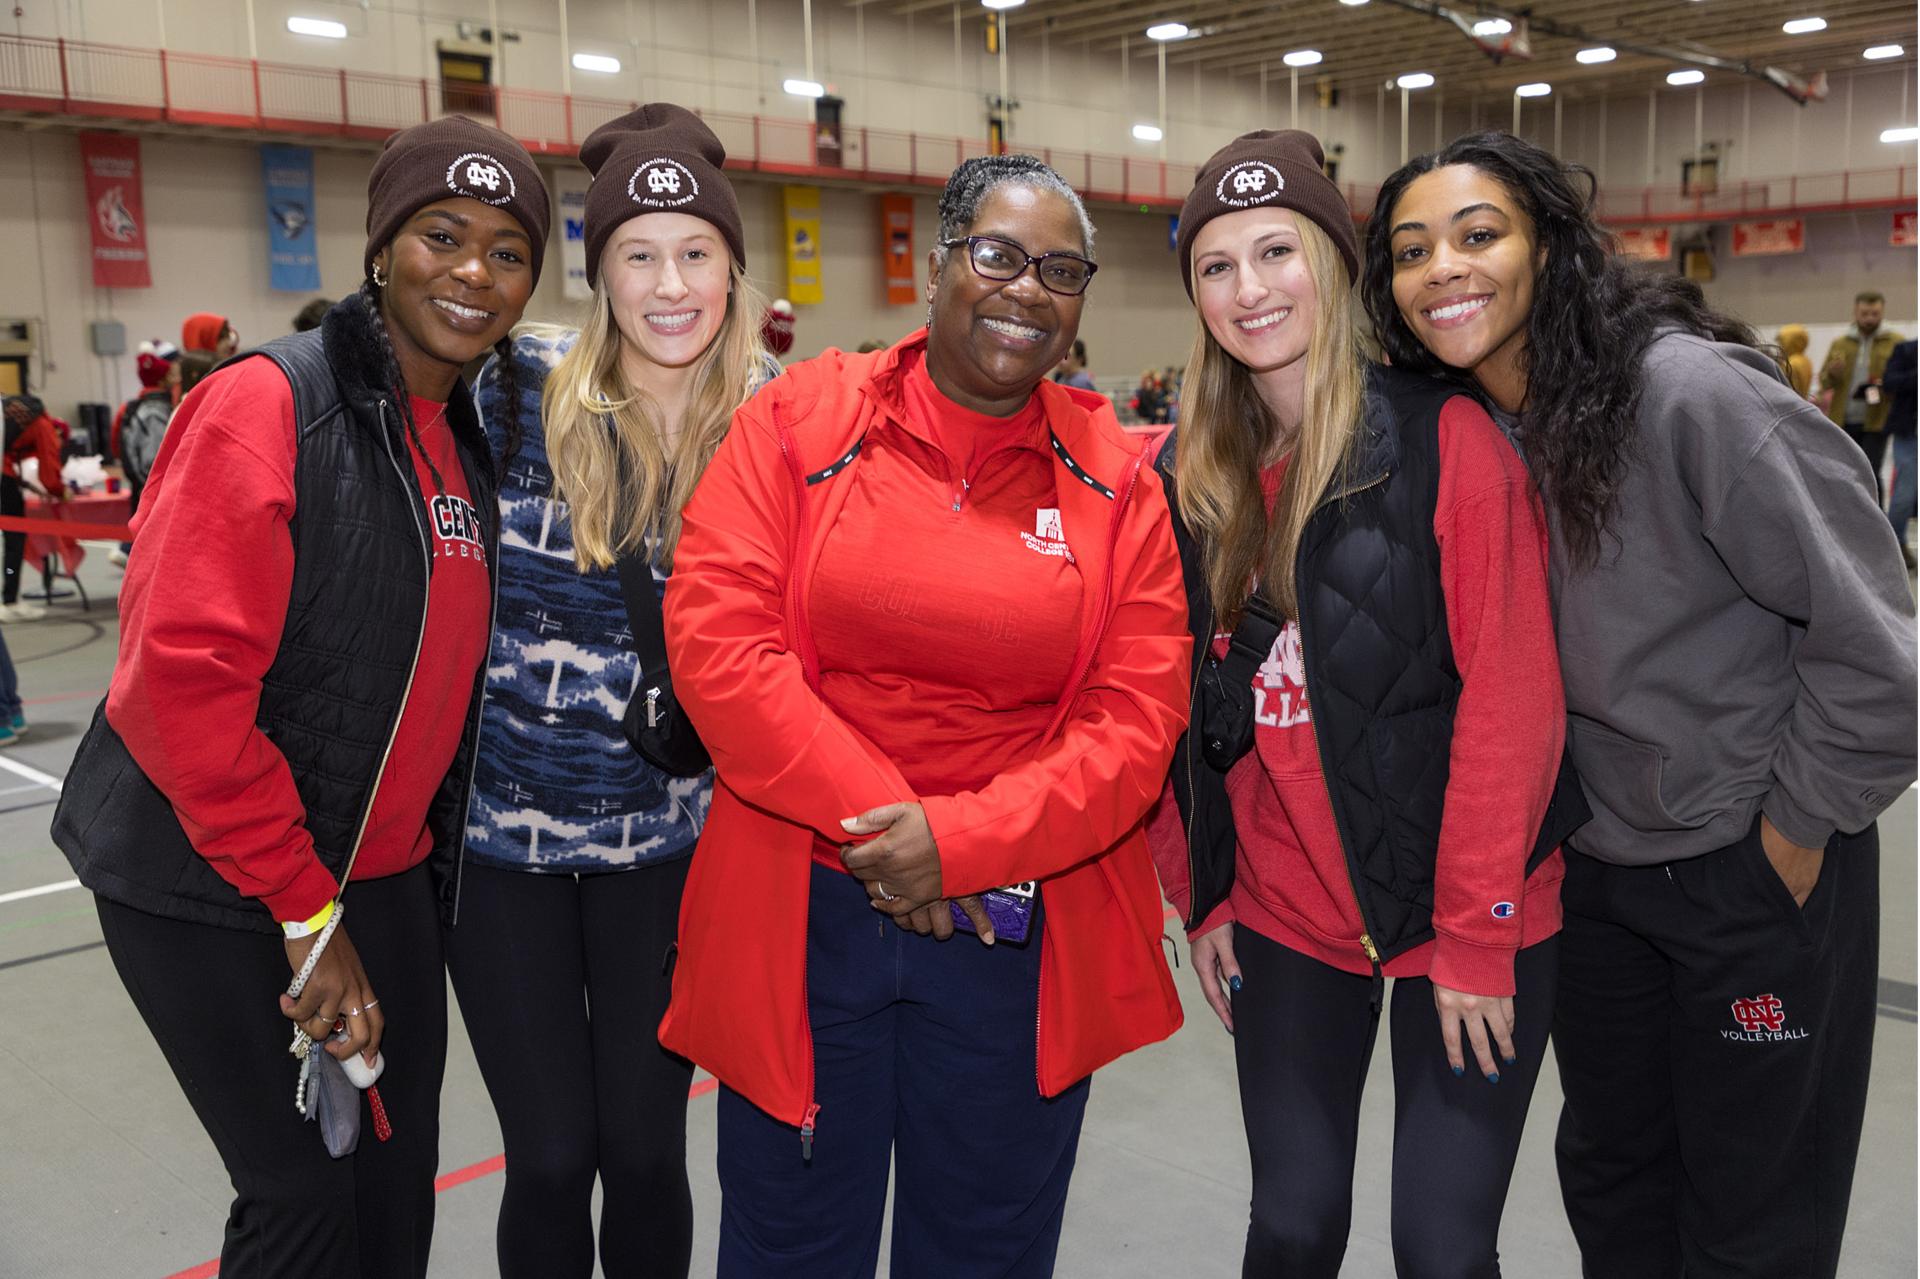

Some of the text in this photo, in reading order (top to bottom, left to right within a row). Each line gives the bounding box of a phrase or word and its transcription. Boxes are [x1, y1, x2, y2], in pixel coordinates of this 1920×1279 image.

[642, 197, 665, 207] Anita
[666, 194, 694, 207] Thomas
[1228, 198, 1248, 207] Anita
[1250, 190, 1280, 205] Thomas
[1020, 531, 1047, 548] NORTH
[1026, 540, 1064, 556] COLLEGE
[1720, 1027, 1810, 1042] VOLLEYBALL
